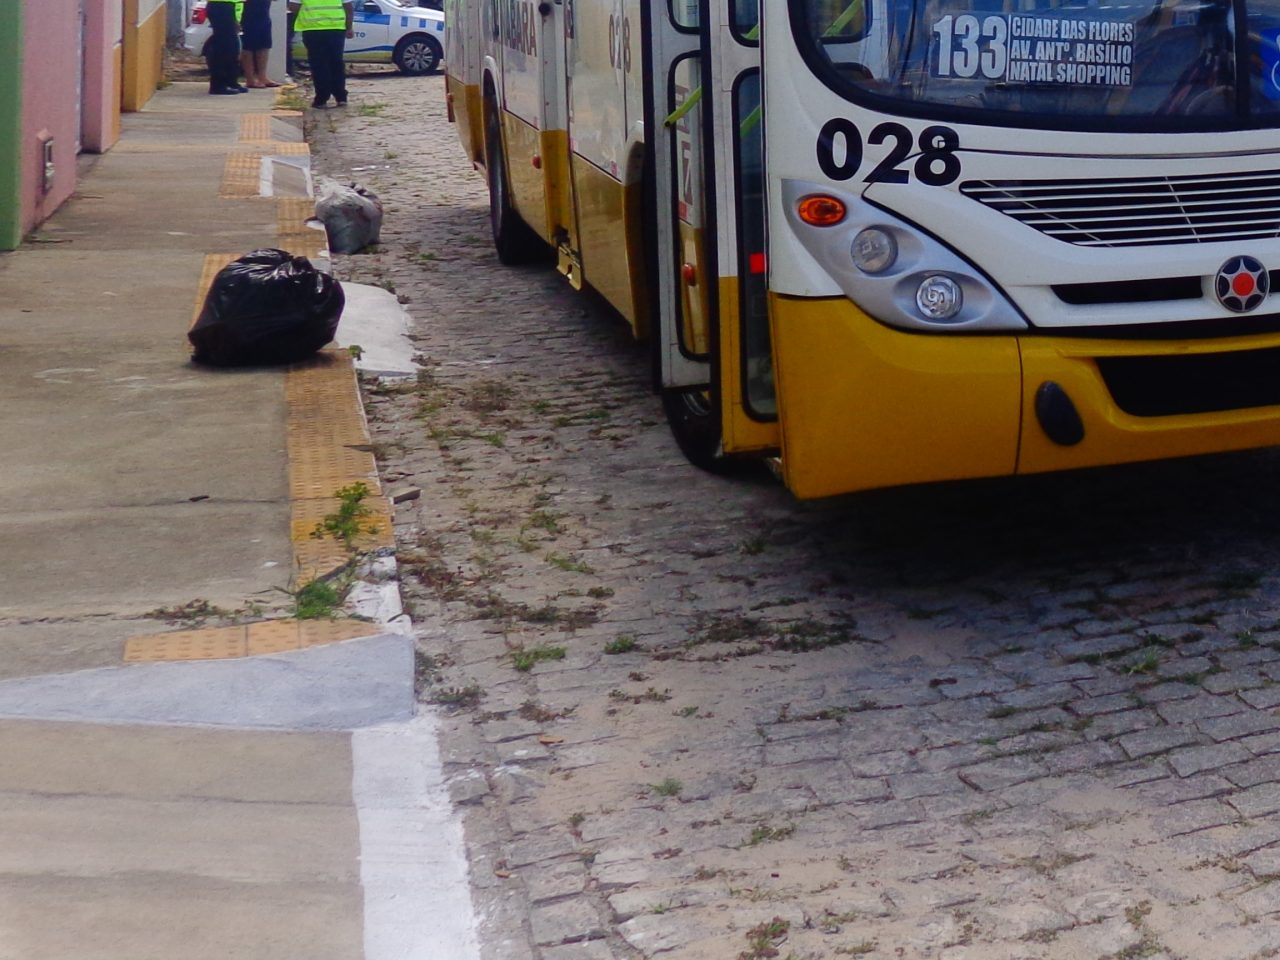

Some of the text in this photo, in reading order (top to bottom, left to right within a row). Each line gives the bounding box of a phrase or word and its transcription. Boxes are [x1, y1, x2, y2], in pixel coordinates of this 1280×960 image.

[1012, 16, 1133, 42] CIDADE DAS FLORES
[933, 14, 1008, 78] 133
[1010, 39, 1033, 60] AV.
[1076, 41, 1132, 65] BASÍLIO
[1010, 62, 1131, 85] NATAL SHOPPING
[816, 117, 962, 186] 028
